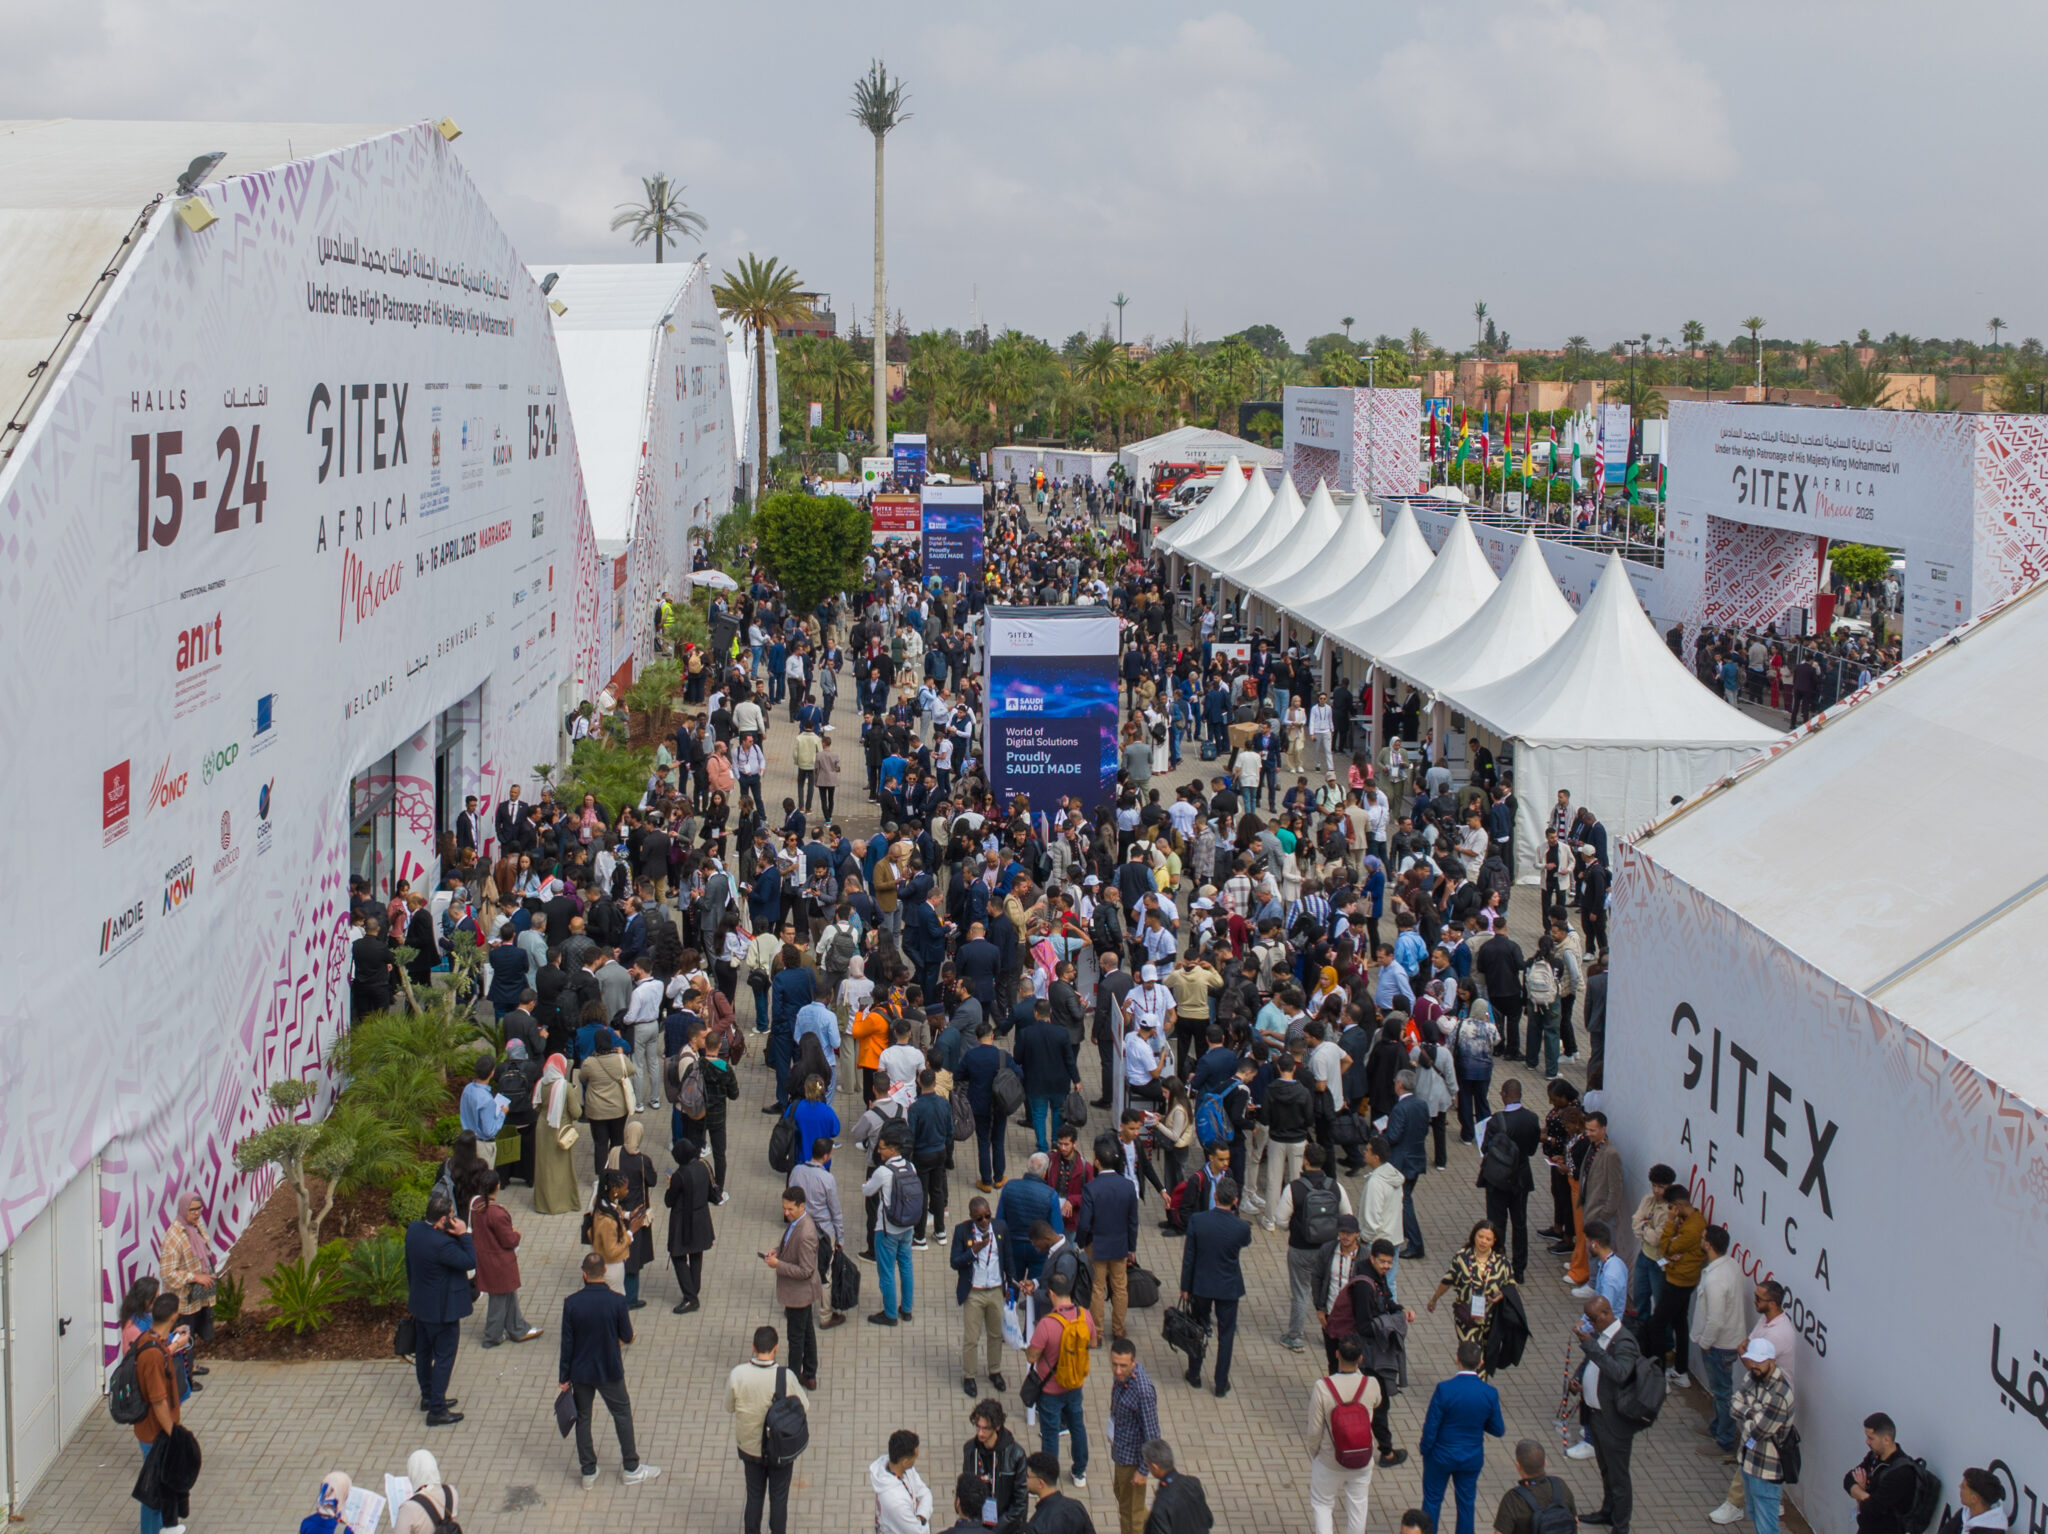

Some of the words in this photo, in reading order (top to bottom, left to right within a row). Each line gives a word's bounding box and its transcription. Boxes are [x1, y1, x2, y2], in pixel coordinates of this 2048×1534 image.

[318, 232, 360, 266] السادس
[362, 246, 386, 275] محمد
[389, 246, 412, 278] الملك
[307, 281, 340, 313] Under
[342, 286, 358, 317] the
[360, 288, 381, 326] High
[382, 293, 422, 330] Patronage
[423, 299, 431, 324] of
[432, 300, 442, 327] His
[443, 303, 466, 335] Majesty
[467, 307, 480, 337] King
[480, 311, 509, 336] Mohammed
[131, 389, 187, 413] HALLS
[307, 382, 409, 484] GITEX
[1744, 430, 1760, 442] محمد
[1761, 430, 1778, 443] الملك
[1780, 430, 1800, 446] الجلالة
[1800, 434, 1824, 448] لصاحب
[1824, 434, 1850, 451] السامية
[1852, 438, 1874, 454] الرعاية
[1875, 440, 1893, 453] تحت
[1715, 444, 1731, 454] Under
[1732, 444, 1741, 455] the
[1742, 446, 1756, 460] High
[1757, 448, 1788, 464] Patronage
[1788, 451, 1795, 462] of
[1796, 452, 1806, 464] His
[1806, 454, 1830, 469] Majesty
[1832, 456, 1848, 471] King
[1848, 458, 1890, 473] Mohammed
[1892, 462, 1900, 474] VI
[1732, 465, 1808, 514] GITEX
[1812, 476, 1874, 496] AFRICA
[1814, 490, 1854, 519] Morocco
[1856, 506, 1874, 520] 2025
[316, 492, 408, 554] AFRICA
[416, 552, 424, 578] 14
[430, 546, 438, 572] 16
[440, 538, 460, 568] APRIL
[461, 532, 476, 558] 2025
[479, 519, 512, 550] MARRAKECH
[339, 547, 405, 644] Morocco
[176, 610, 222, 672] anrt
[344, 675, 394, 720] WELCOME
[437, 622, 478, 658] BIENVENUE
[1006, 728, 1032, 736] World
[1034, 728, 1044, 736] of
[1006, 738, 1034, 748] Digital
[1036, 738, 1078, 746] Solutions
[216, 742, 239, 772] OCP
[1006, 752, 1051, 764] Proudly
[1006, 764, 1044, 774] SAUDI
[1047, 764, 1082, 774] MADE
[160, 771, 189, 808] ONCF
[166, 855, 193, 881] MOROCCO
[213, 846, 240, 875] MOROCCO
[162, 867, 195, 917] NOW
[112, 900, 144, 942] AMDIE
[1670, 1001, 1839, 1221] GITEX
[1680, 1117, 1831, 1292] AFRICA
[1780, 1286, 1828, 1358] 2025
